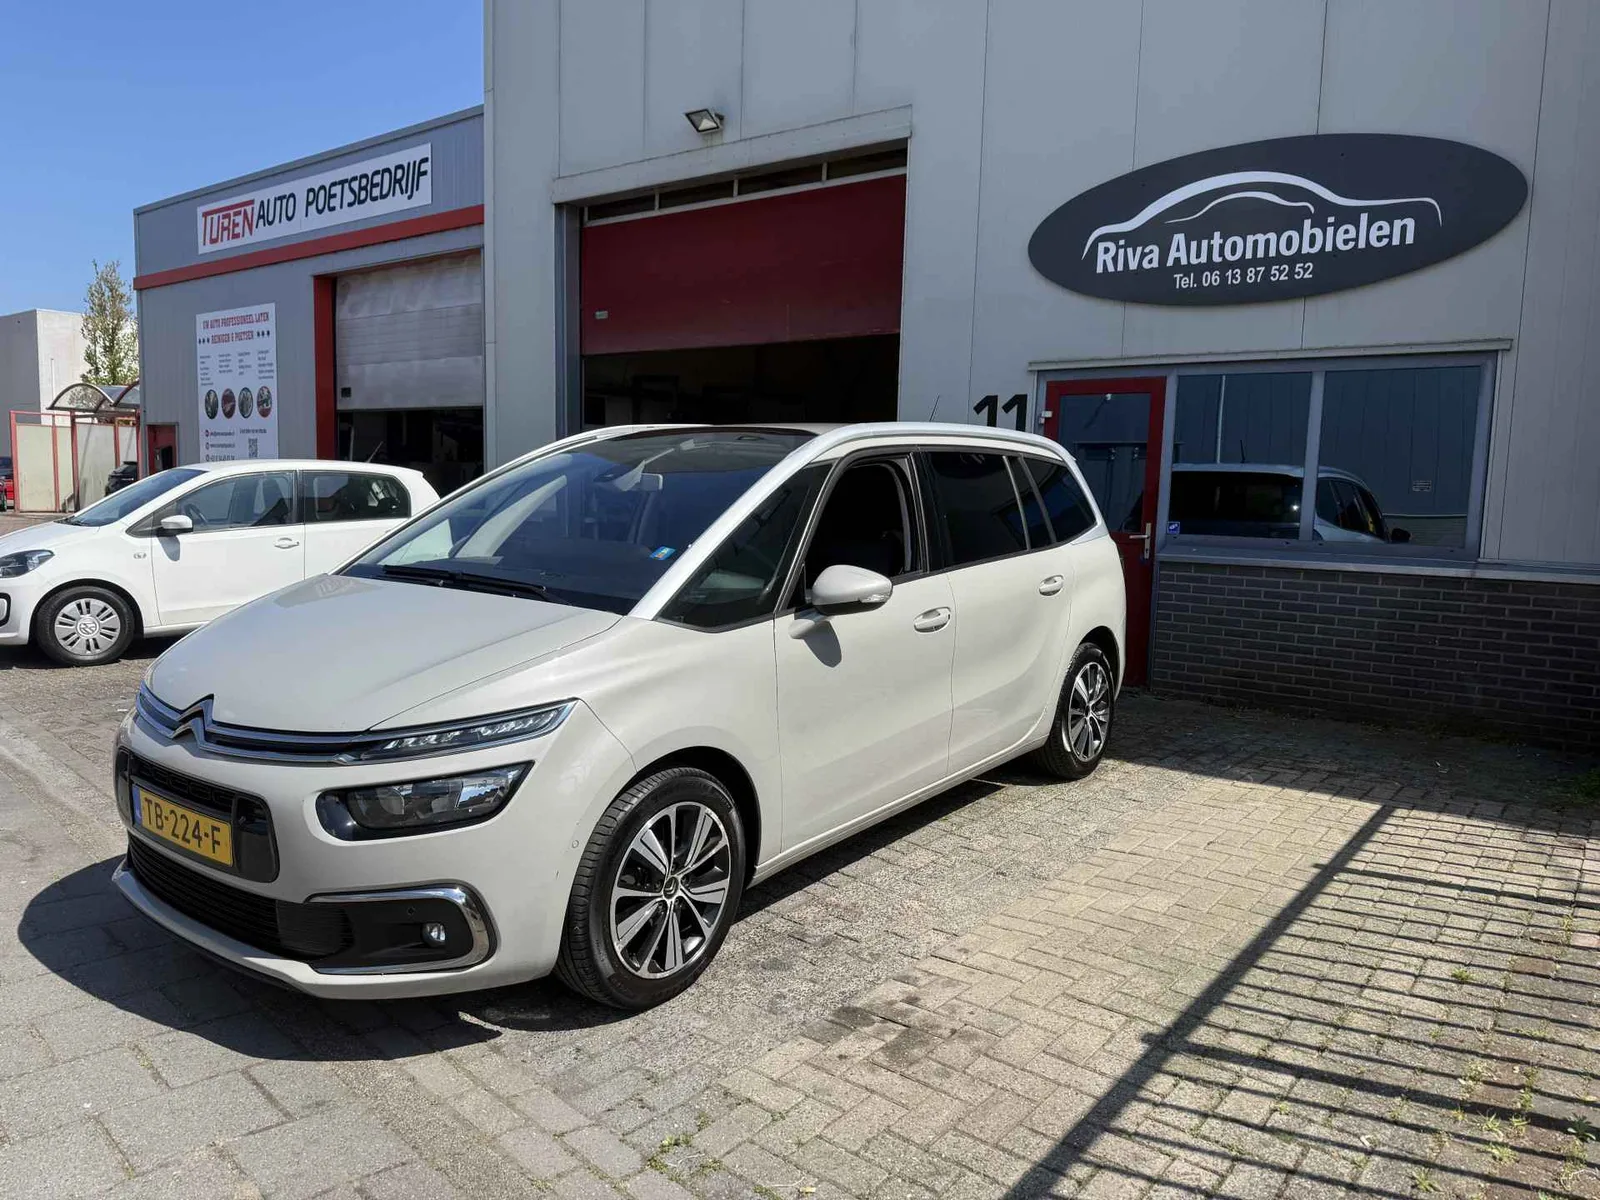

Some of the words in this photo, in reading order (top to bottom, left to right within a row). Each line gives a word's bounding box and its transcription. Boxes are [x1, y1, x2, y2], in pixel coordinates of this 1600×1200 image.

[202, 200, 255, 246] TUREN
[255, 192, 297, 229] AUTO
[305, 157, 429, 218] POETSBEDRIJF
[1095, 239, 1160, 273] Riva
[1166, 212, 1416, 267] Automobielen
[1173, 273, 1198, 289] Tel.
[1201, 270, 1221, 287] 06
[1225, 268, 1242, 285] 13
[1246, 266, 1266, 284] 87
[1270, 264, 1289, 282] 52
[1294, 262, 1314, 279] 52
[973, 394, 1028, 432] 11
[144, 797, 221, 854] TB-224-F
